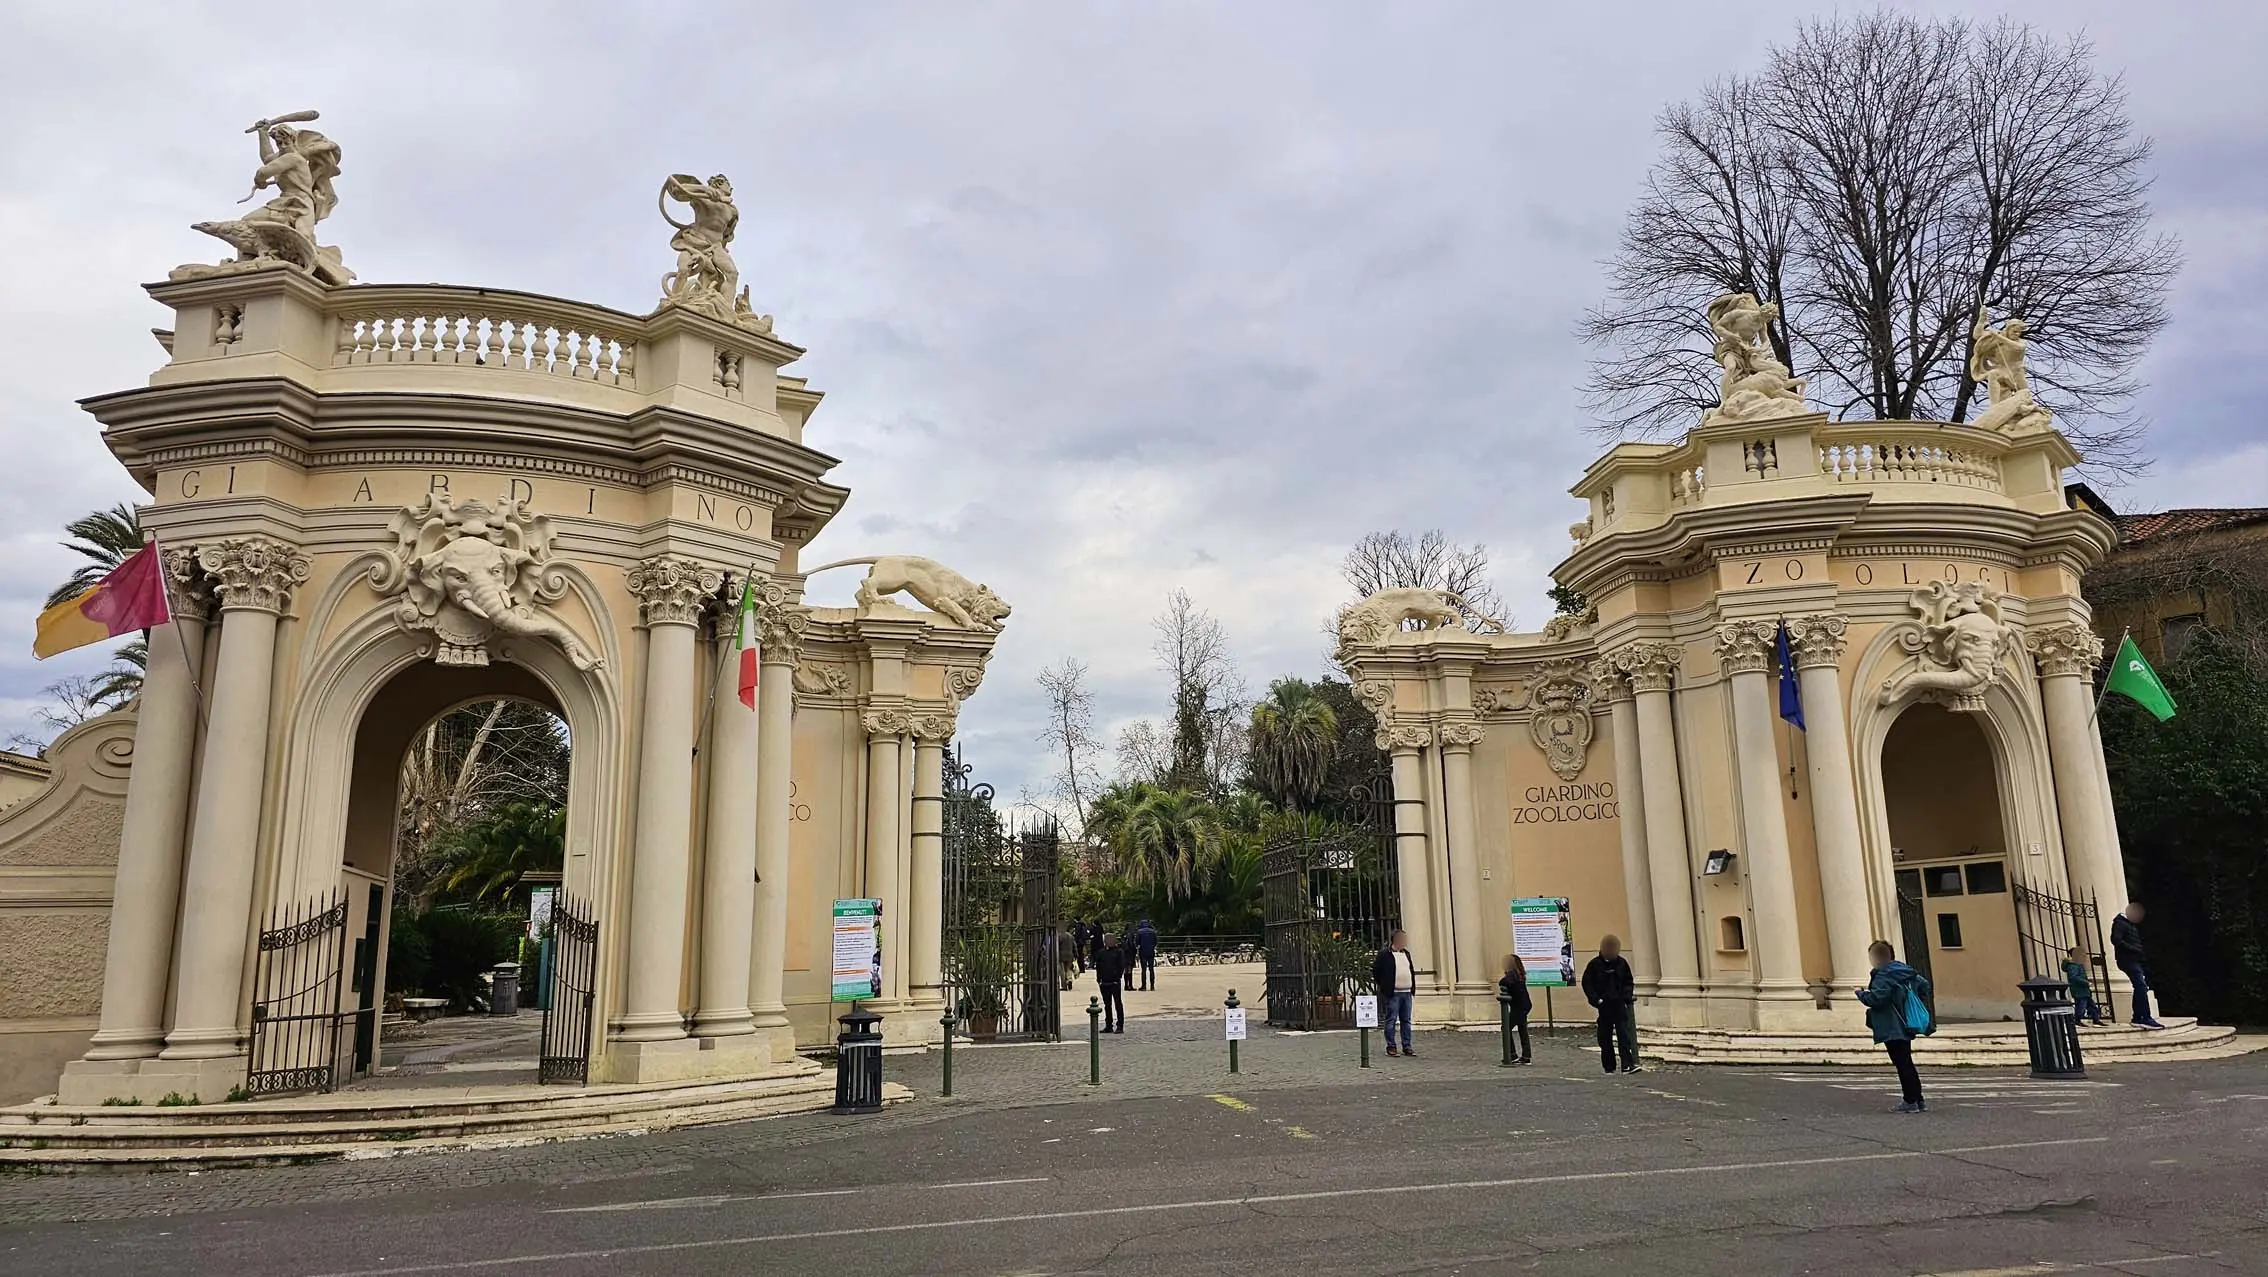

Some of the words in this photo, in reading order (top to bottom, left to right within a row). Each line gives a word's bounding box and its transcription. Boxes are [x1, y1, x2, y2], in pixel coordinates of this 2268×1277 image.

[181, 465, 753, 532] GIARDINO
[1743, 558, 2073, 595] ZOOLOGI
[1525, 781, 1614, 803] GIARDINO
[2031, 844, 2039, 853] 3
